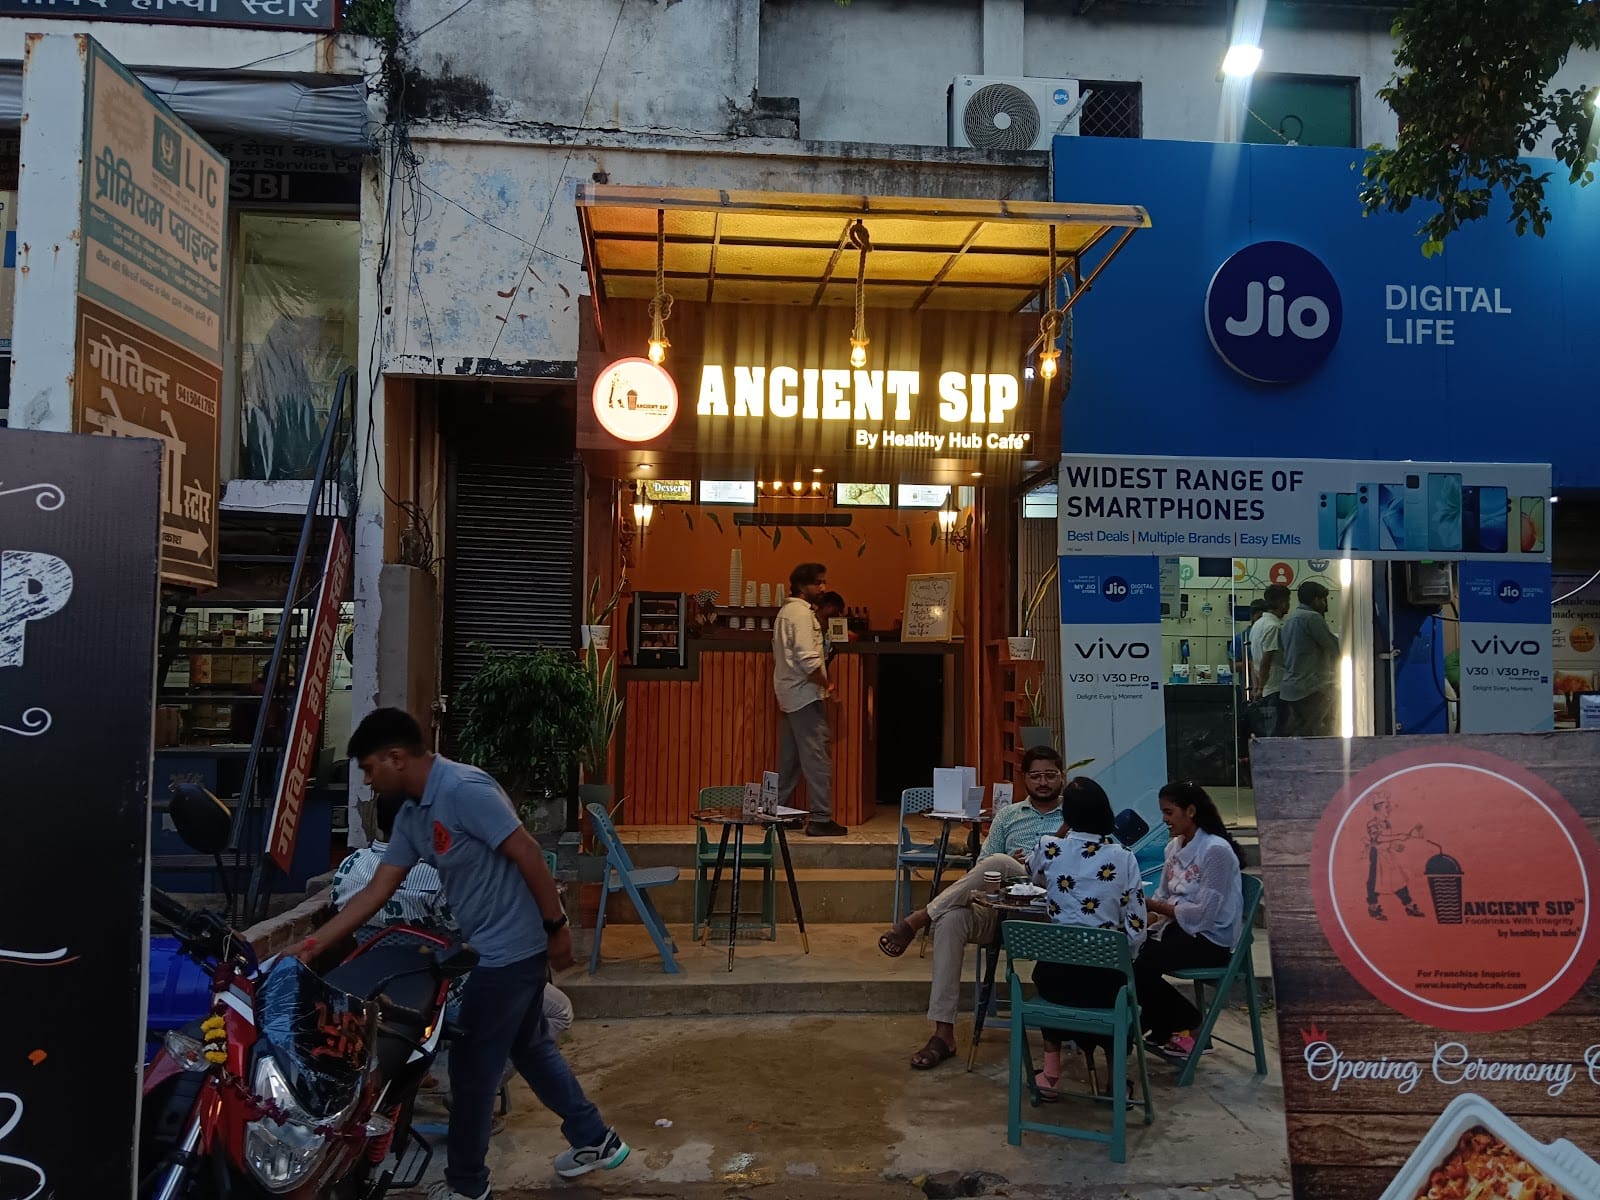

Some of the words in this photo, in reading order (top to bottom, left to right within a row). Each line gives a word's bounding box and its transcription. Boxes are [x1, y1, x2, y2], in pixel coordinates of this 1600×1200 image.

[185, 148, 218, 208] LIC
[230, 172, 290, 200] SBI
[95, 146, 165, 234] प्रीमियम
[1225, 275, 1331, 340] Jio
[1386, 284, 1512, 314] DIGITAL
[1386, 318, 1455, 345] LIFE
[88, 334, 171, 405] गोविन्द
[697, 364, 920, 421] ANCIENT
[938, 371, 1019, 423] SIP
[856, 430, 878, 449] By
[882, 430, 945, 451] Healthy
[949, 432, 982, 448] Hub
[1067, 466, 1167, 490] WIDEST
[1176, 469, 1263, 491] RANGE
[1271, 470, 1304, 491] OF
[1067, 496, 1265, 521] SMARTPHONES
[1067, 531, 1094, 542] Best
[1097, 531, 1129, 542] Deals
[1138, 531, 1185, 544] Multiple
[1189, 533, 1231, 544] Brands
[1240, 533, 1268, 546] Easy
[1271, 534, 1301, 545] EMIs
[1105, 582, 1127, 595] Jio
[1500, 586, 1519, 597] Jio
[1074, 637, 1150, 659] vivo
[1471, 634, 1540, 655] vivo
[1069, 673, 1094, 683] V30
[1102, 673, 1127, 683] V30
[1130, 673, 1149, 683] Pro
[1466, 667, 1489, 676] V30
[1496, 667, 1519, 676] V30
[1522, 668, 1540, 677] Pro
[1076, 693, 1098, 701] Delight
[1099, 693, 1117, 701] Every
[1463, 901, 1540, 915] ANCIENT
[1536, 917, 1574, 926] Integrity
[1498, 929, 1508, 939] by
[1510, 929, 1541, 938] healthy
[1542, 929, 1558, 937] hub
[1417, 969, 1432, 978] For
[1481, 970, 1521, 979] Inquiries
[1304, 1040, 1423, 1094] Opening
[1432, 1041, 1577, 1097] Ceremony
